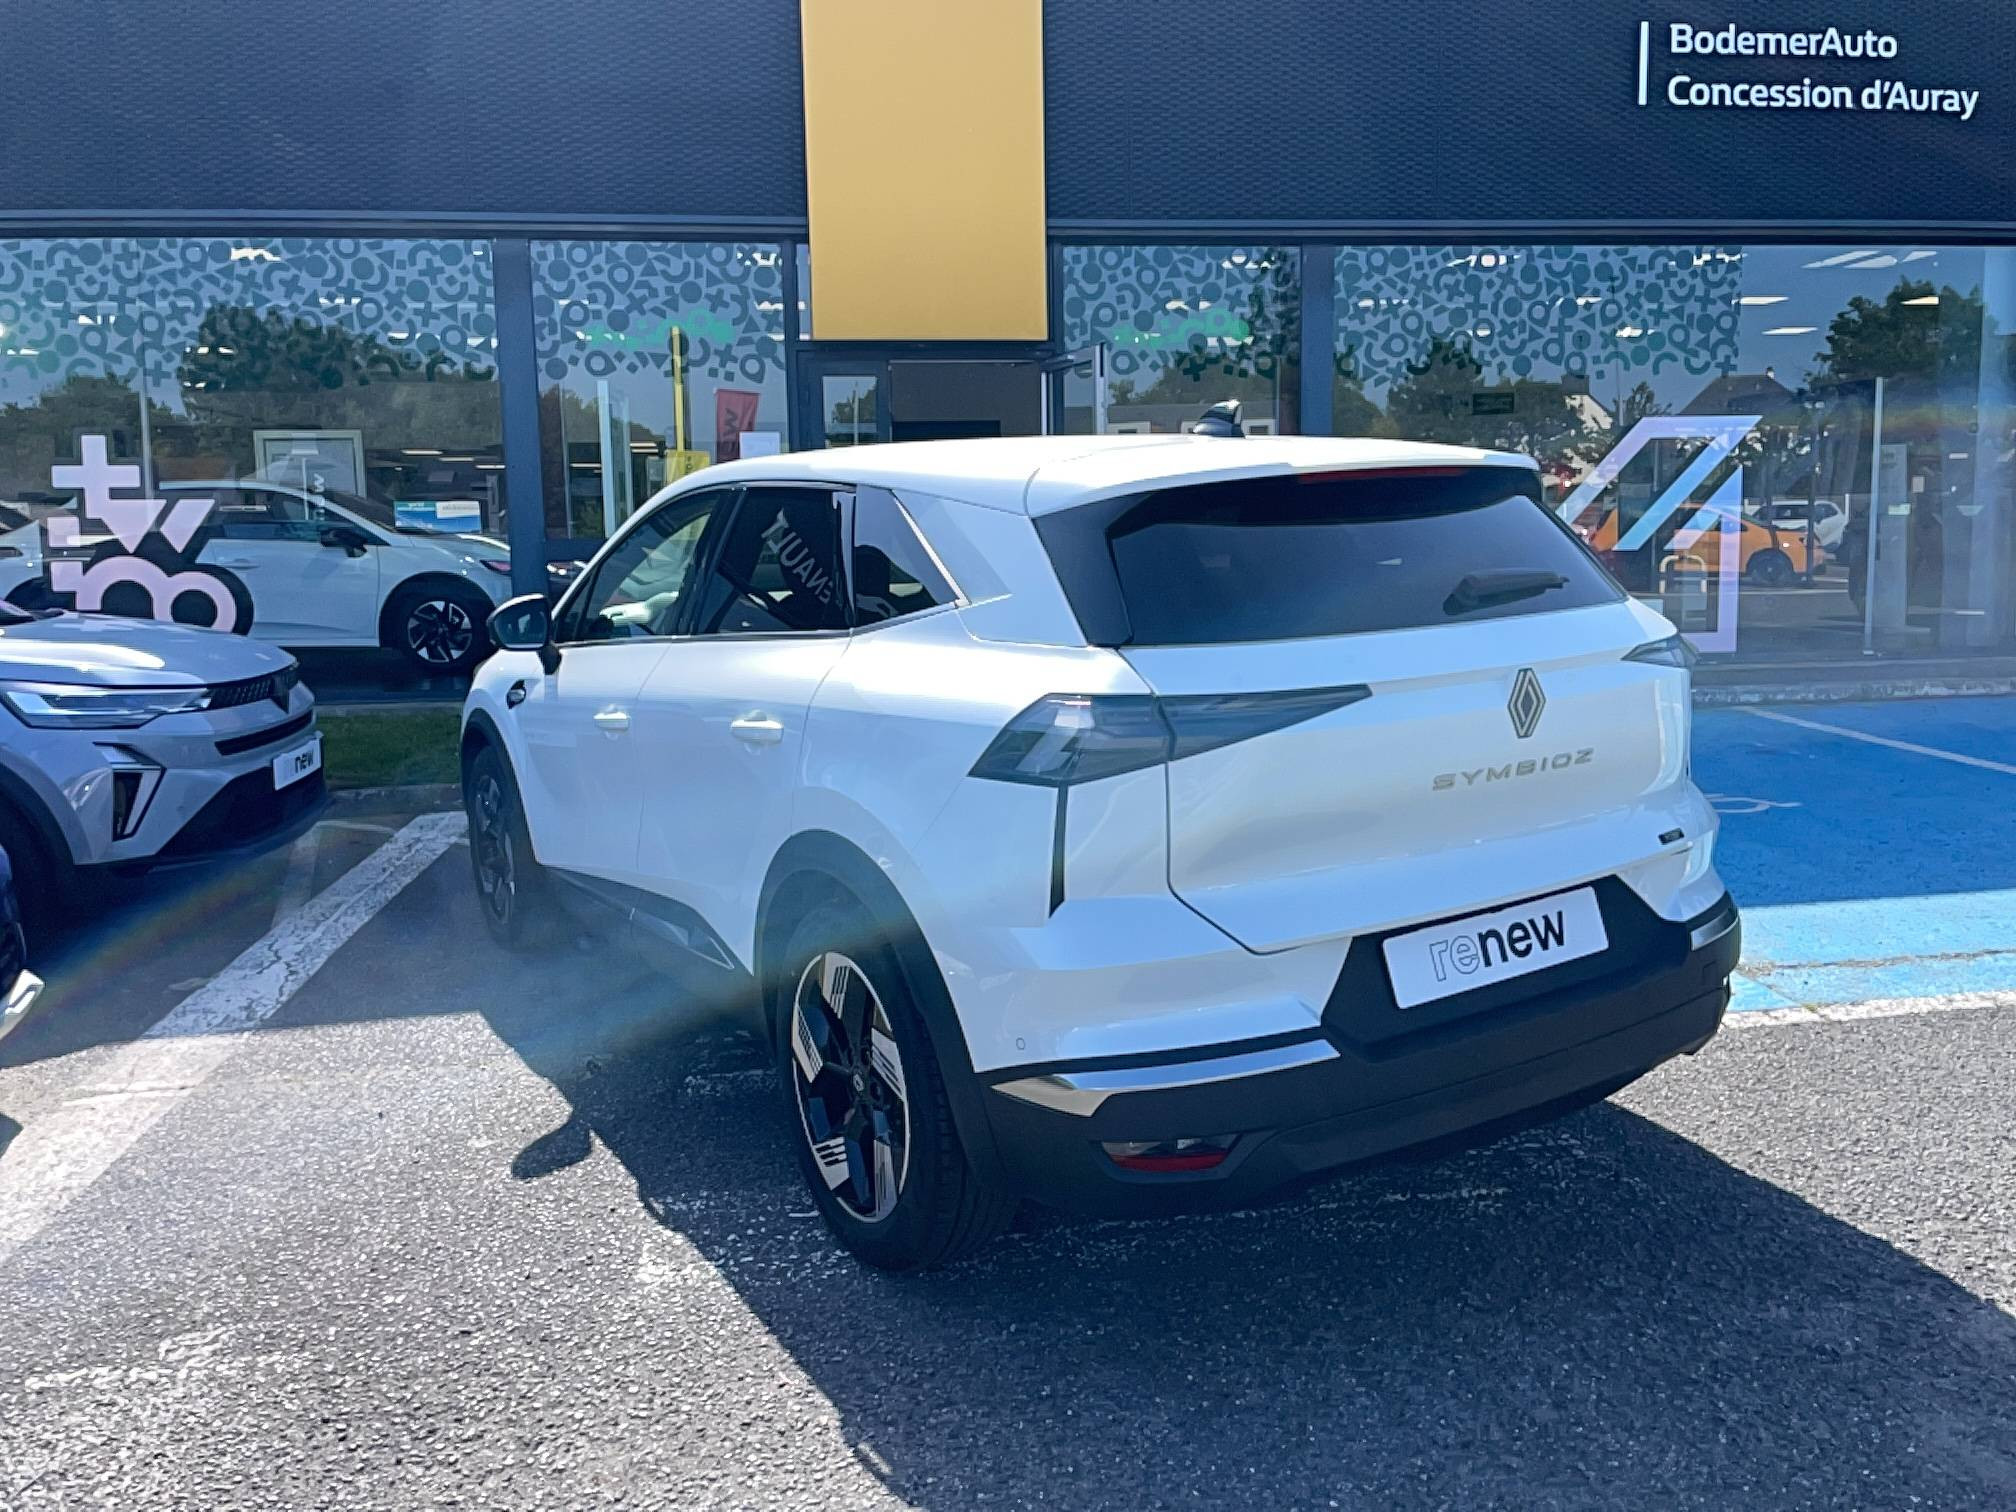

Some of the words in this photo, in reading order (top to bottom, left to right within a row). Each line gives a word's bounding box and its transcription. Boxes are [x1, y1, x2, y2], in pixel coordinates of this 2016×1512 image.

[1669, 22, 1898, 59] BodemerAuto
[1667, 75, 1854, 110] Concession
[1860, 78, 1980, 121] d'Auray
[1431, 747, 1595, 791] SYMBIOZ
[1428, 909, 1566, 983] renew
